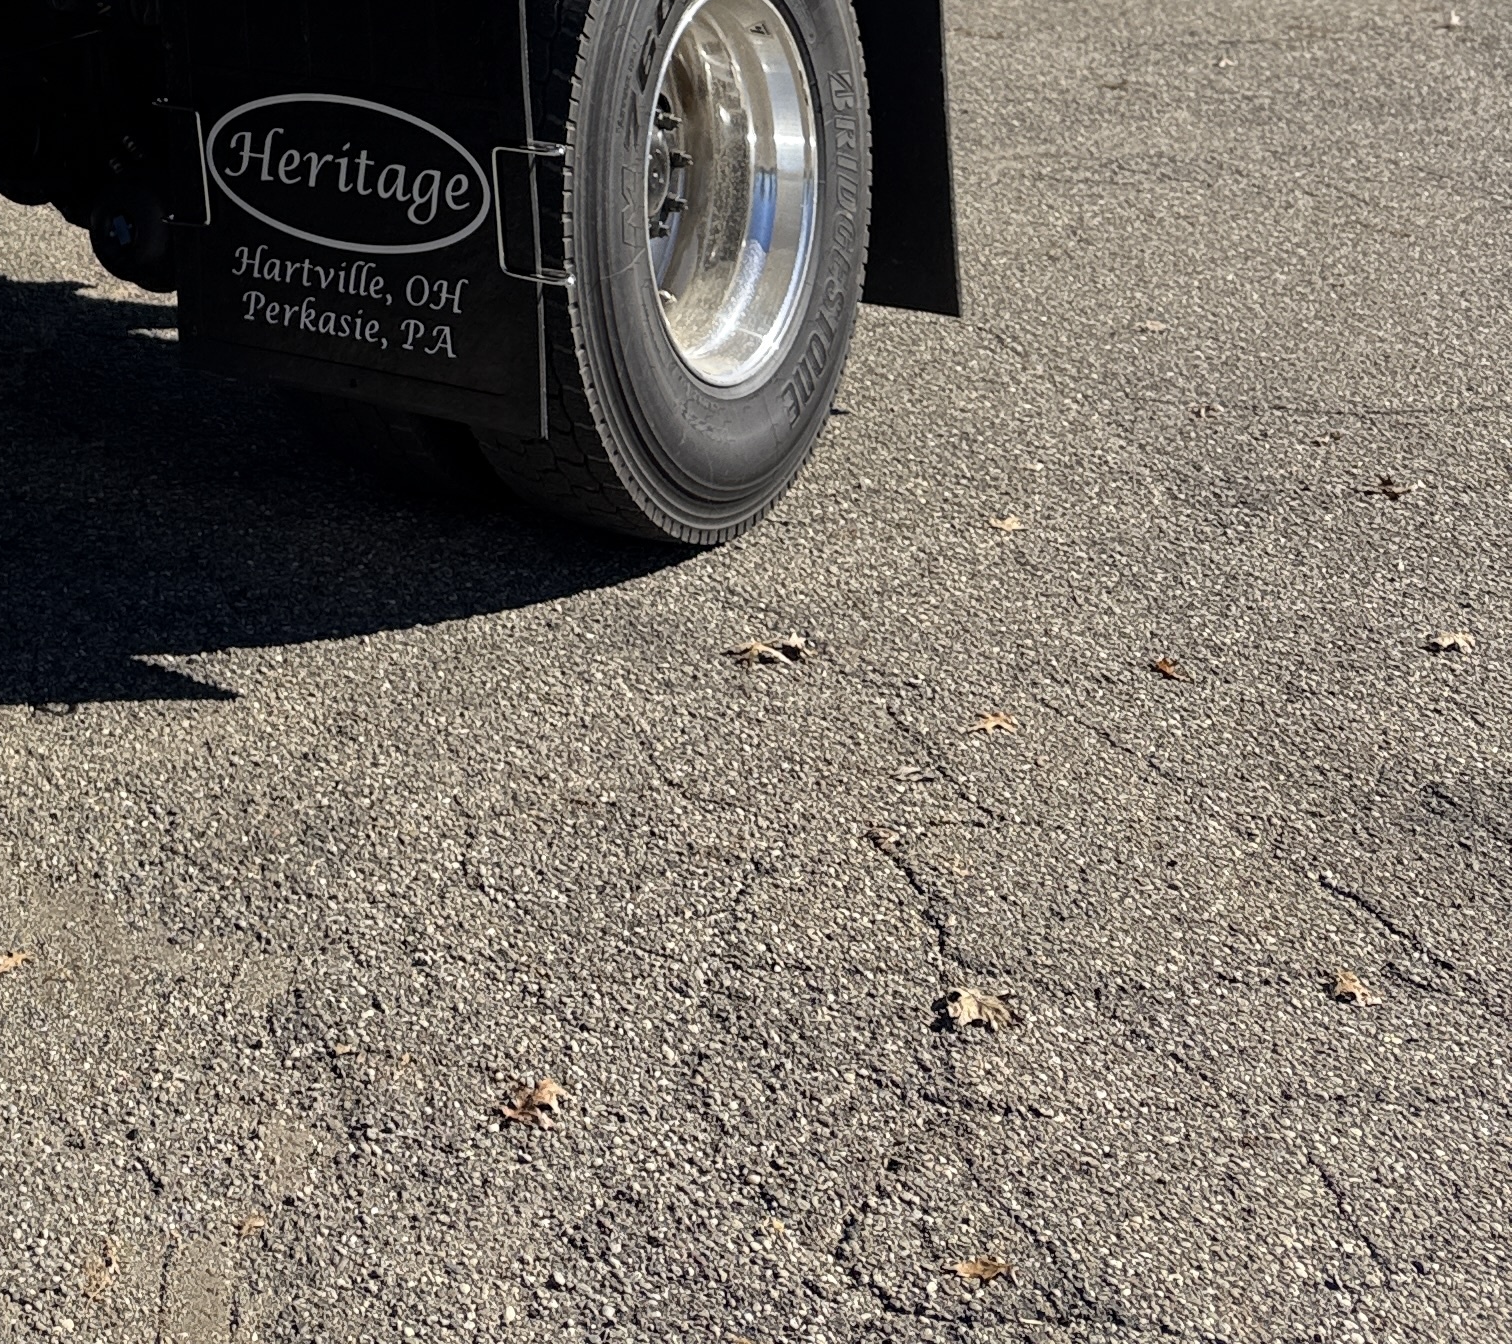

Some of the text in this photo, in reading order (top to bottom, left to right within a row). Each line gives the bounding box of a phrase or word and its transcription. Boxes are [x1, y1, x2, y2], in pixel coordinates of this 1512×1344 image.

[225, 127, 471, 225] Heritage
[232, 244, 469, 313] Hartville, OH
[782, 69, 859, 428] BRIDGESTONE
[242, 291, 457, 358] Perkasie, PA
